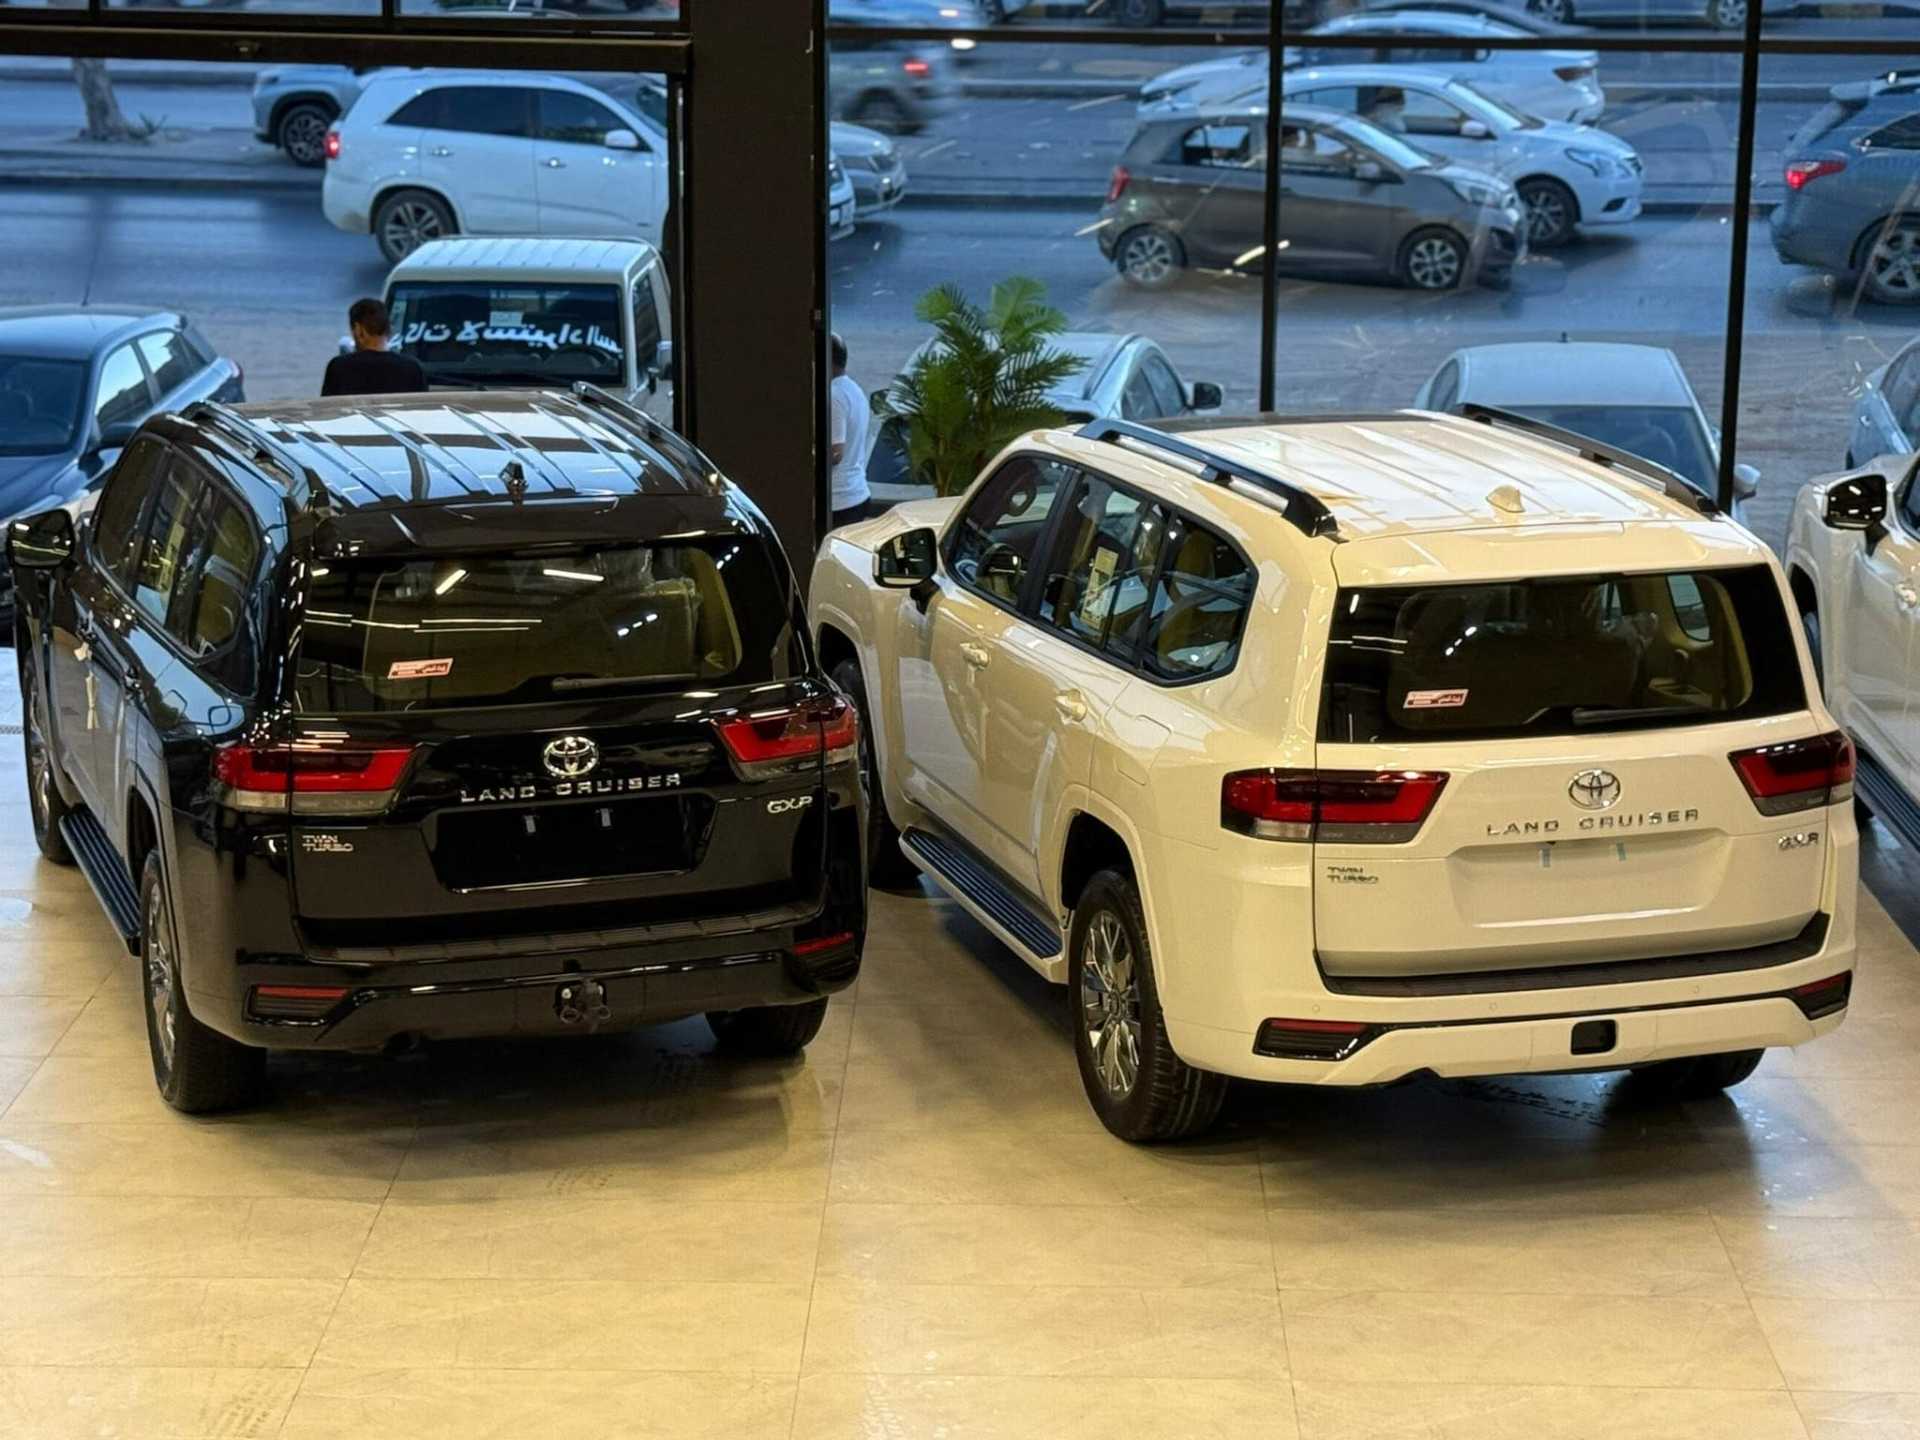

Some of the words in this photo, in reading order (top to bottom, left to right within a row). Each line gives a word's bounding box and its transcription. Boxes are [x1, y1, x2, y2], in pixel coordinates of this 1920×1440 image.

[460, 785, 537, 803] LAND
[555, 772, 682, 796] CRUISER
[1486, 820, 1560, 836] LAND
[1578, 808, 1699, 830] CRUISER
